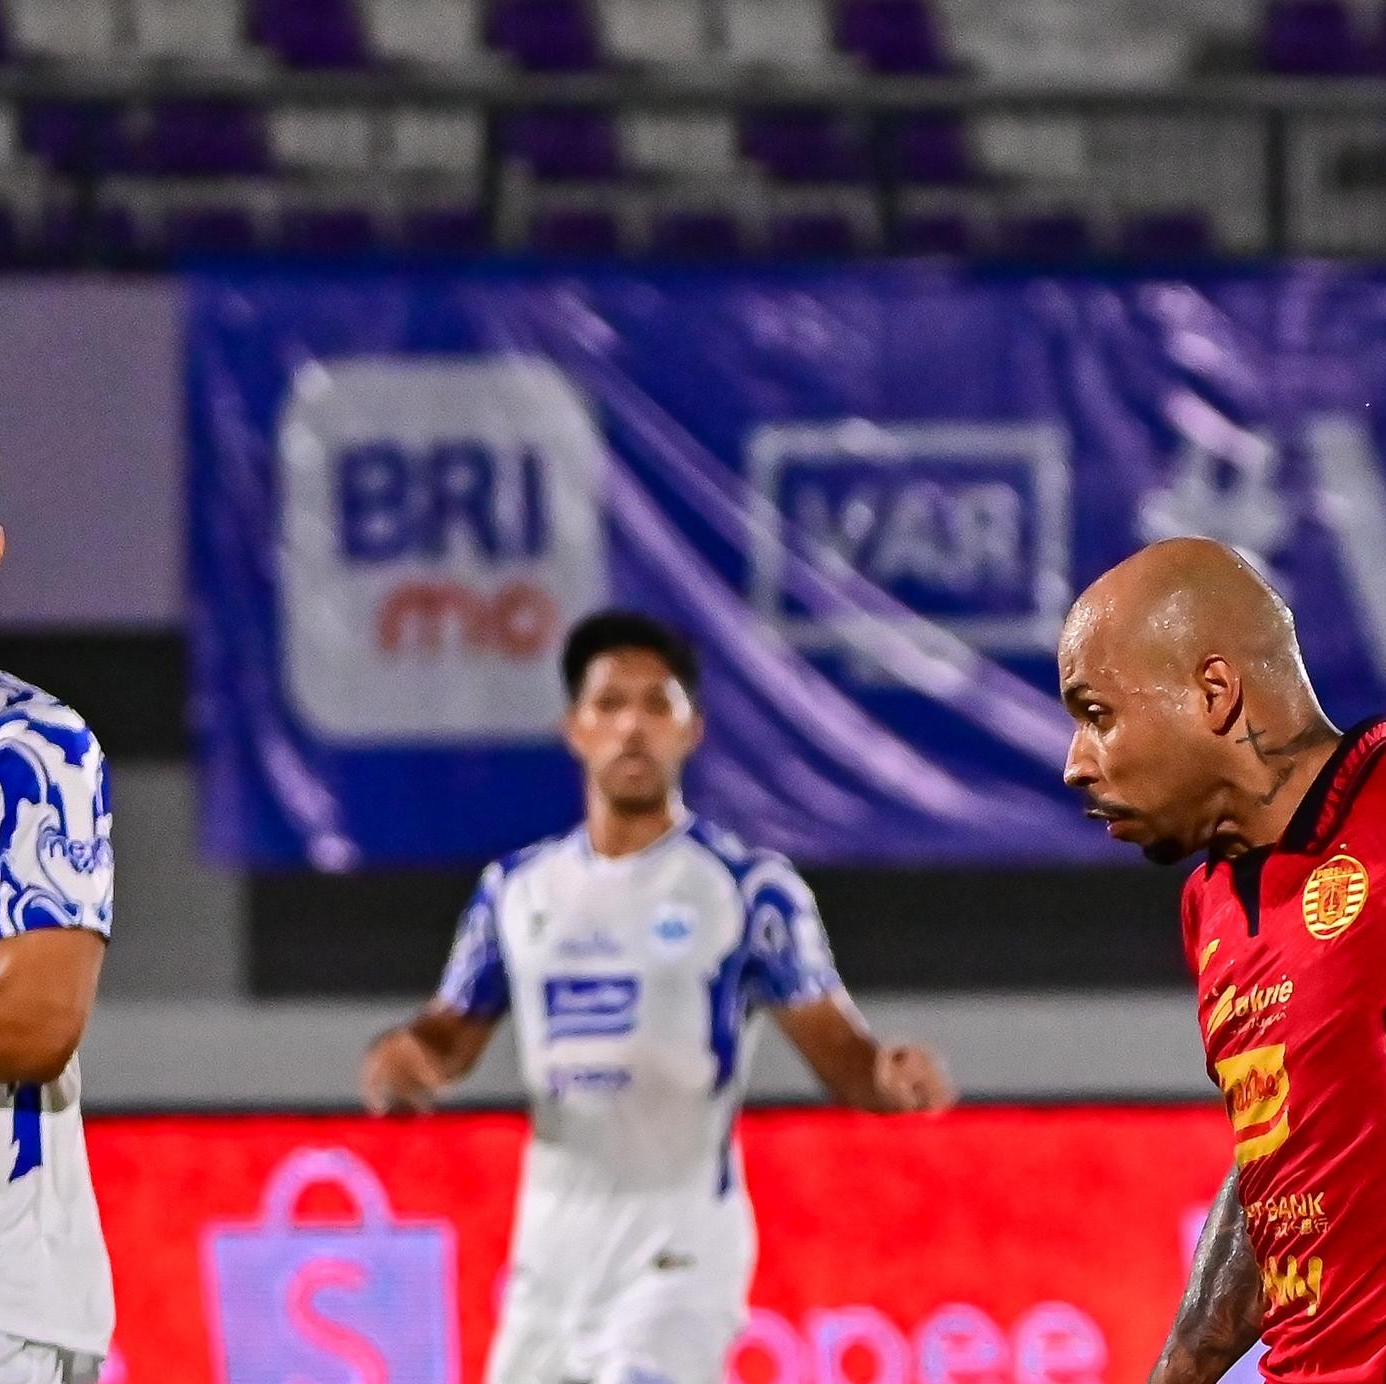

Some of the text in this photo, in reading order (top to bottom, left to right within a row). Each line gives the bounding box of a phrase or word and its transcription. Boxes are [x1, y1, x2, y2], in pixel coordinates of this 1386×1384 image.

[337, 440, 552, 568] BRI
[793, 480, 1025, 590] VAR
[375, 580, 559, 658] mo
[1265, 1191, 1325, 1222] BANK
